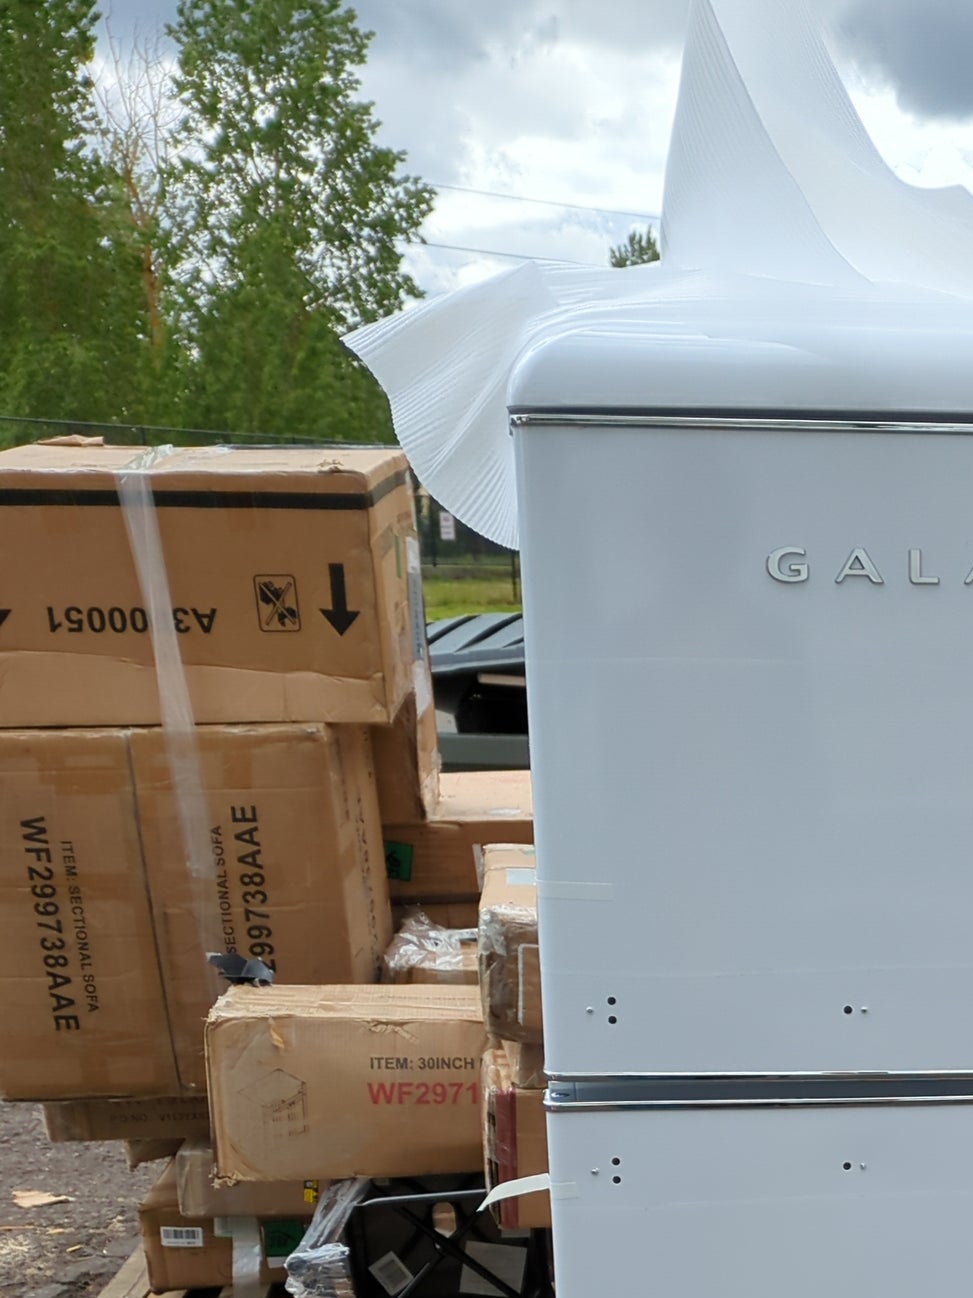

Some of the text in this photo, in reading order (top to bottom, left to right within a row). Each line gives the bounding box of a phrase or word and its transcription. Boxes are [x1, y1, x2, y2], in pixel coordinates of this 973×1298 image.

[47, 606, 217, 634] A300051
[20, 816, 80, 1031] WF299738AAE
[60, 840, 99, 1013] ITEM: SECTIONAL SOFA
[211, 825, 238, 954] SECTIONAL SOFA
[370, 1057, 414, 1070] ITEM:
[418, 1057, 475, 1070] 30INCH
